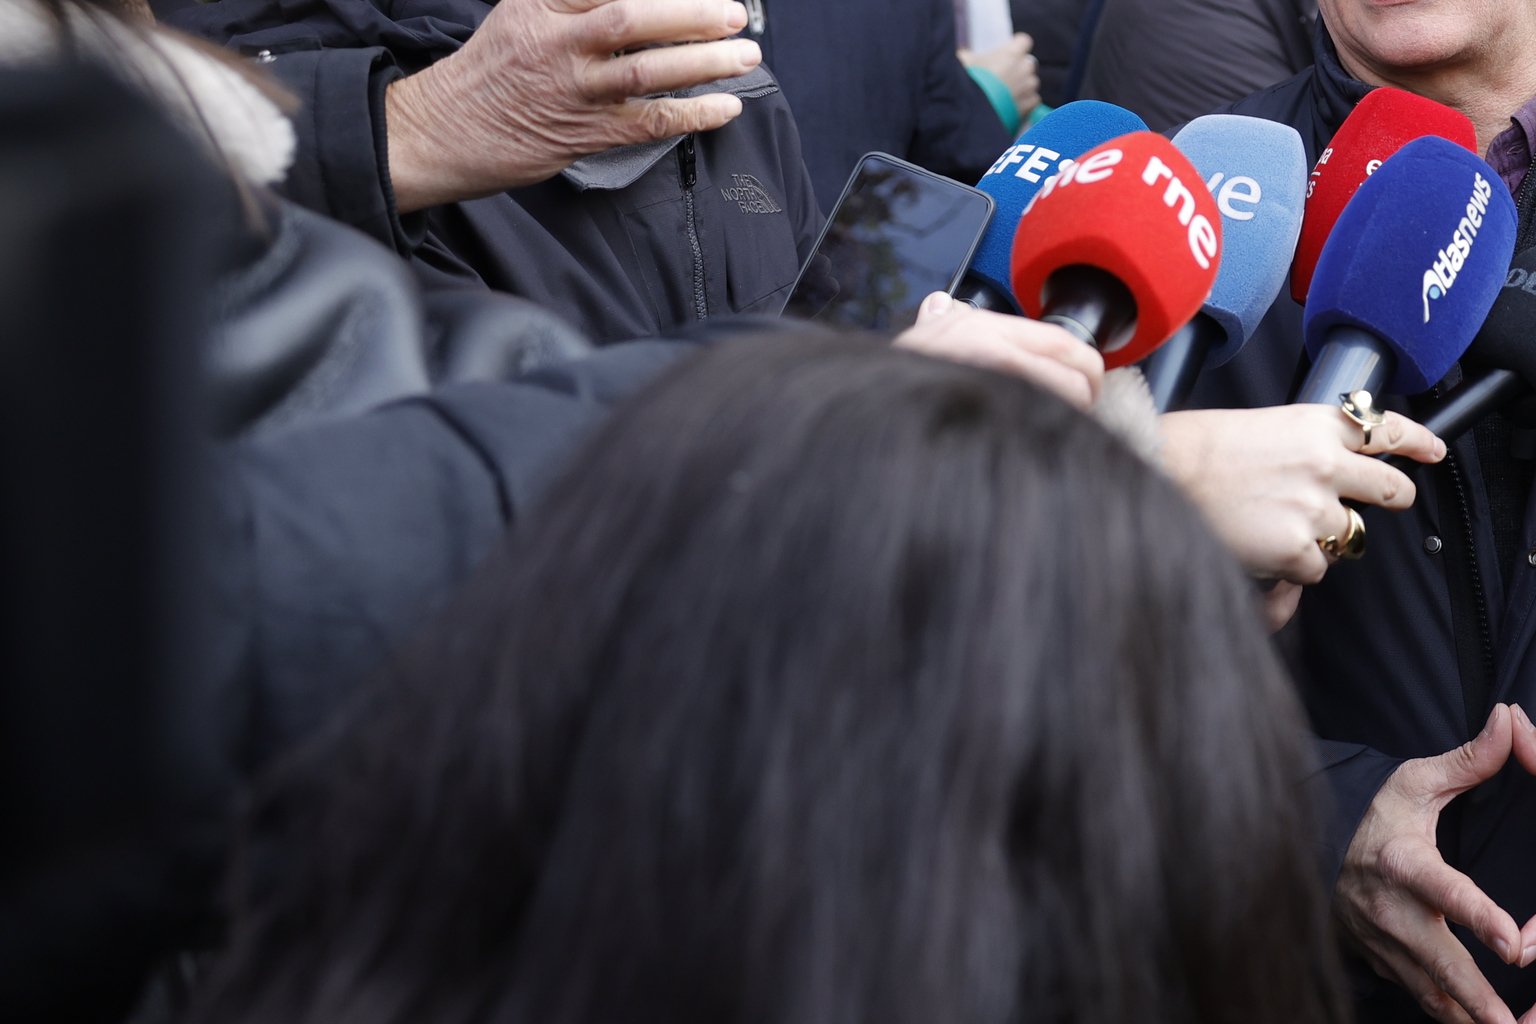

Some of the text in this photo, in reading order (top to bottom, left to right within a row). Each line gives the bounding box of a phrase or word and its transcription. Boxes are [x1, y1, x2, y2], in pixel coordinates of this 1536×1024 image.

[731, 174, 753, 188] THE
[720, 187, 758, 202] NORTH
[738, 201, 766, 214] FACE
[1142, 156, 1218, 270] rne
[1422, 171, 1492, 324] Atlasnews
